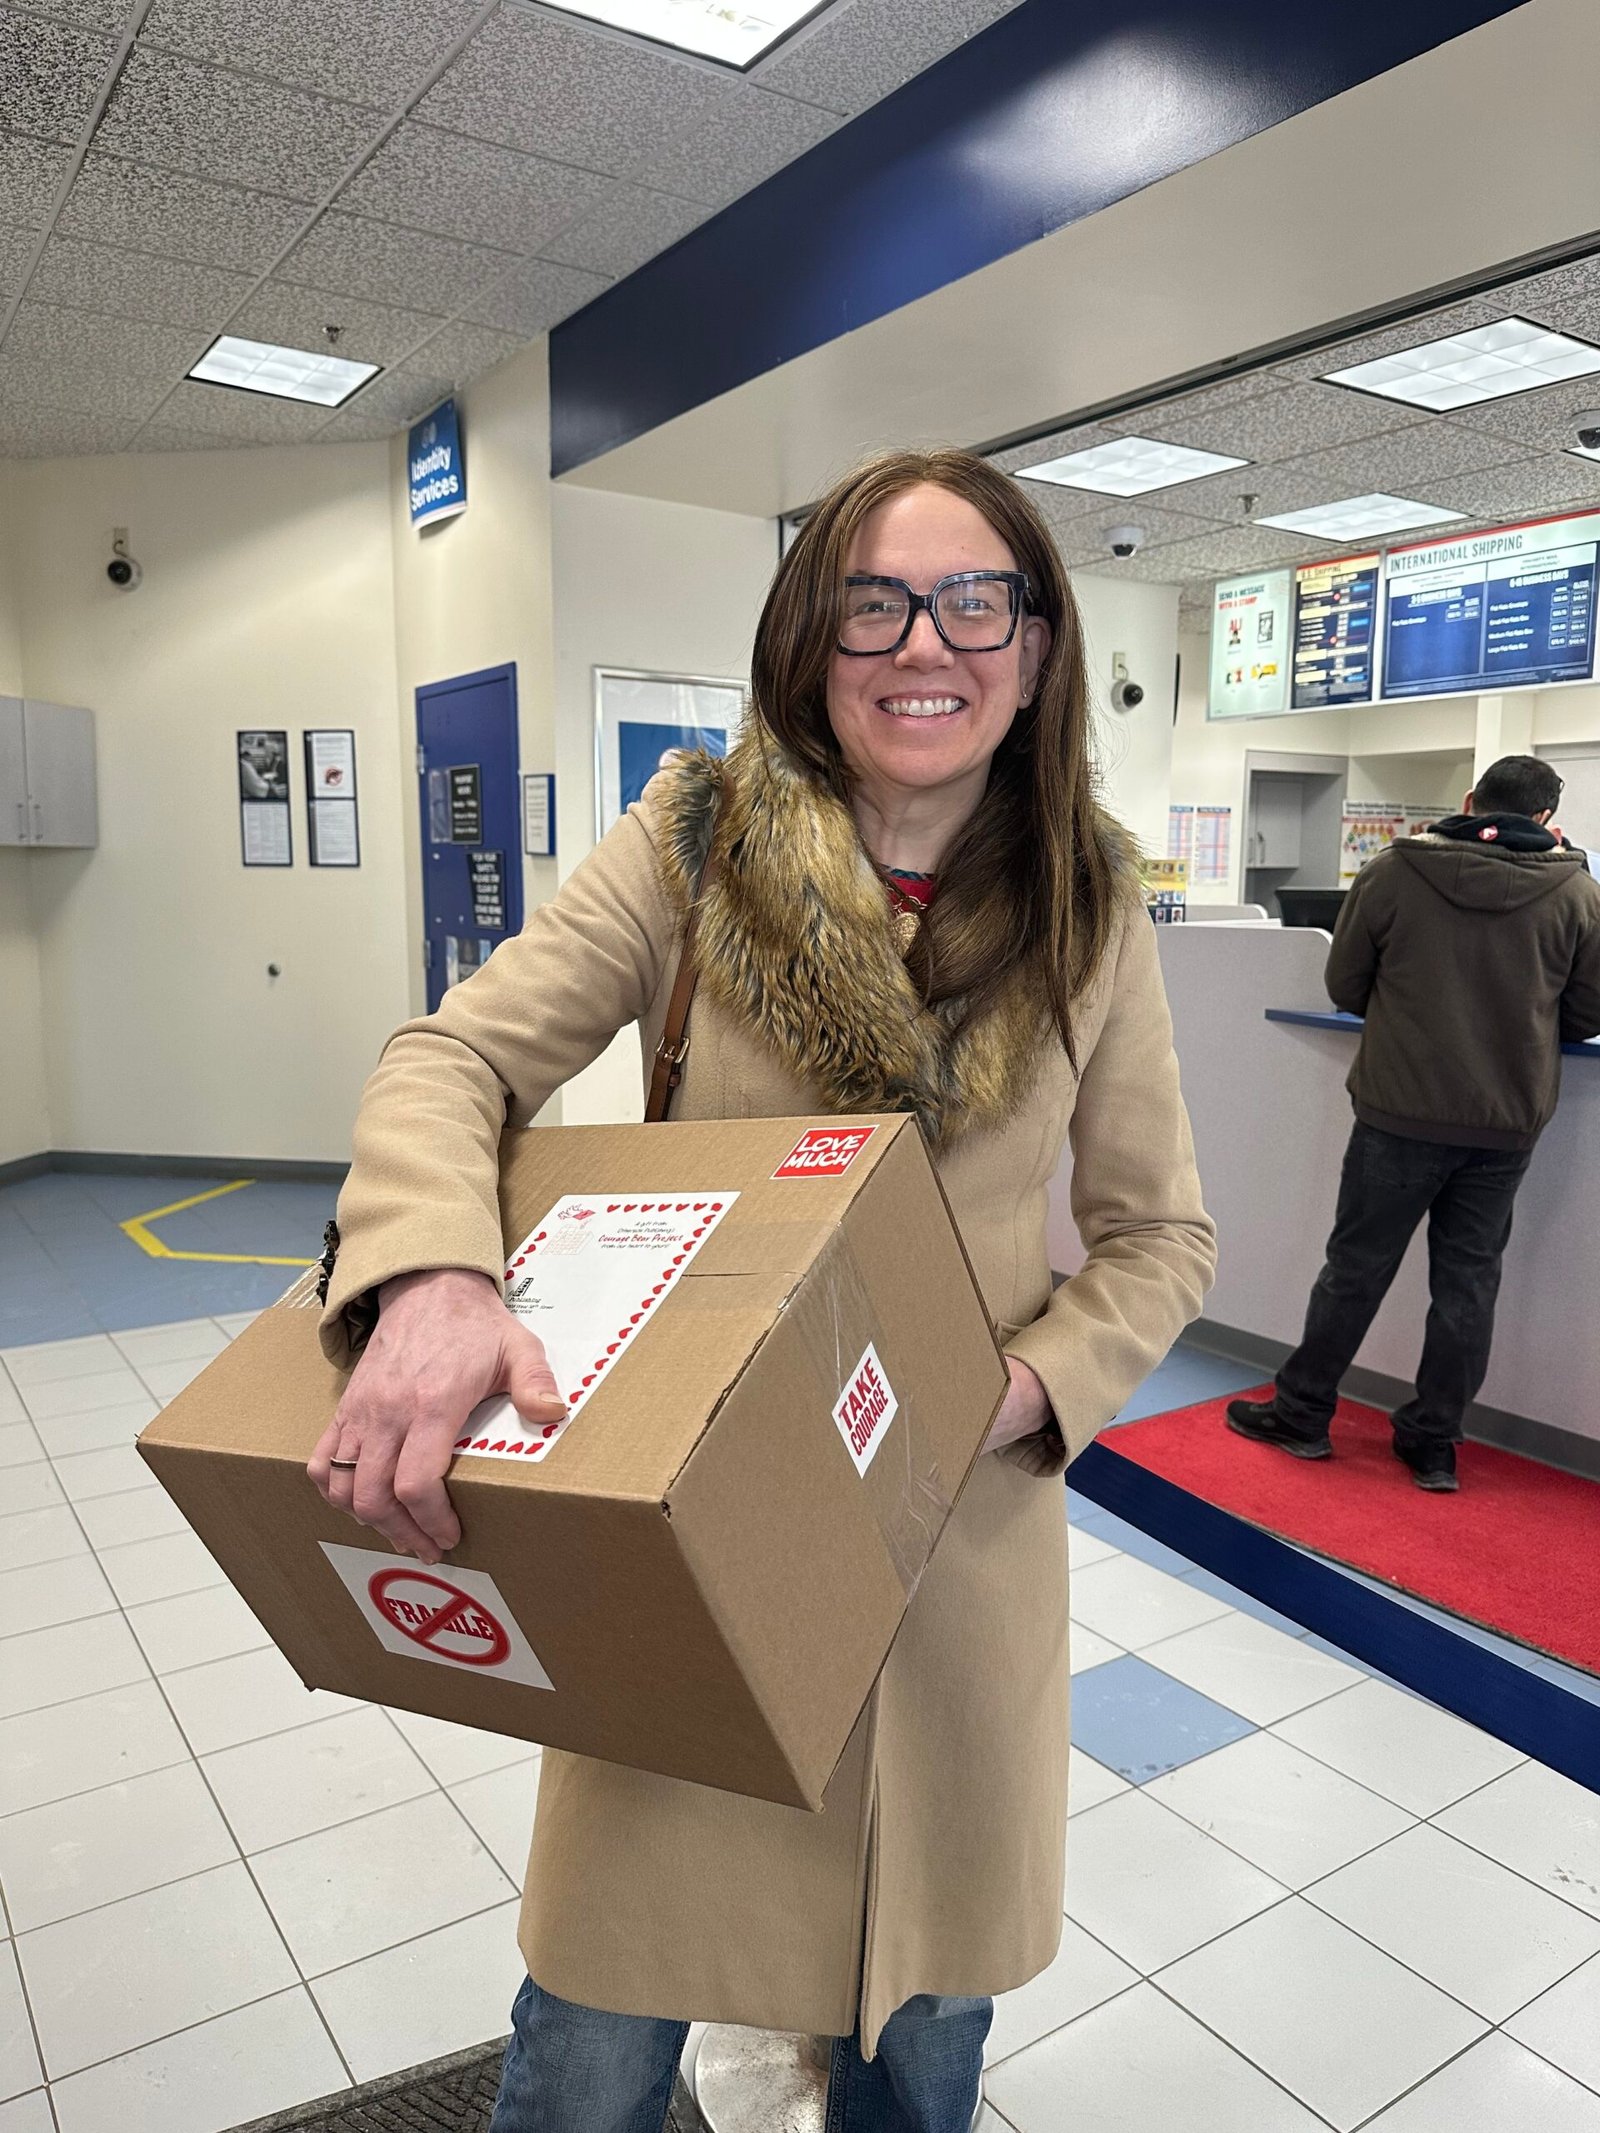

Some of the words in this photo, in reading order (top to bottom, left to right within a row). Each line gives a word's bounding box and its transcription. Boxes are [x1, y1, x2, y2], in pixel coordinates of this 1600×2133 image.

[411, 445, 451, 482] Identity
[411, 474, 459, 511] Services
[1391, 546, 1468, 572] INTERNATIONAL
[1472, 535, 1523, 558] SHIPPING
[1219, 592, 1233, 601] SEND
[1239, 584, 1265, 596] MESSAGE
[783, 1150, 855, 1169] MUCH
[796, 1134, 864, 1153] LOVE
[598, 1234, 631, 1244] Courage
[631, 1234, 651, 1243] Bear
[651, 1233, 684, 1243] Project
[838, 1357, 879, 1431] TAKE
[849, 1380, 889, 1457] COURAGE
